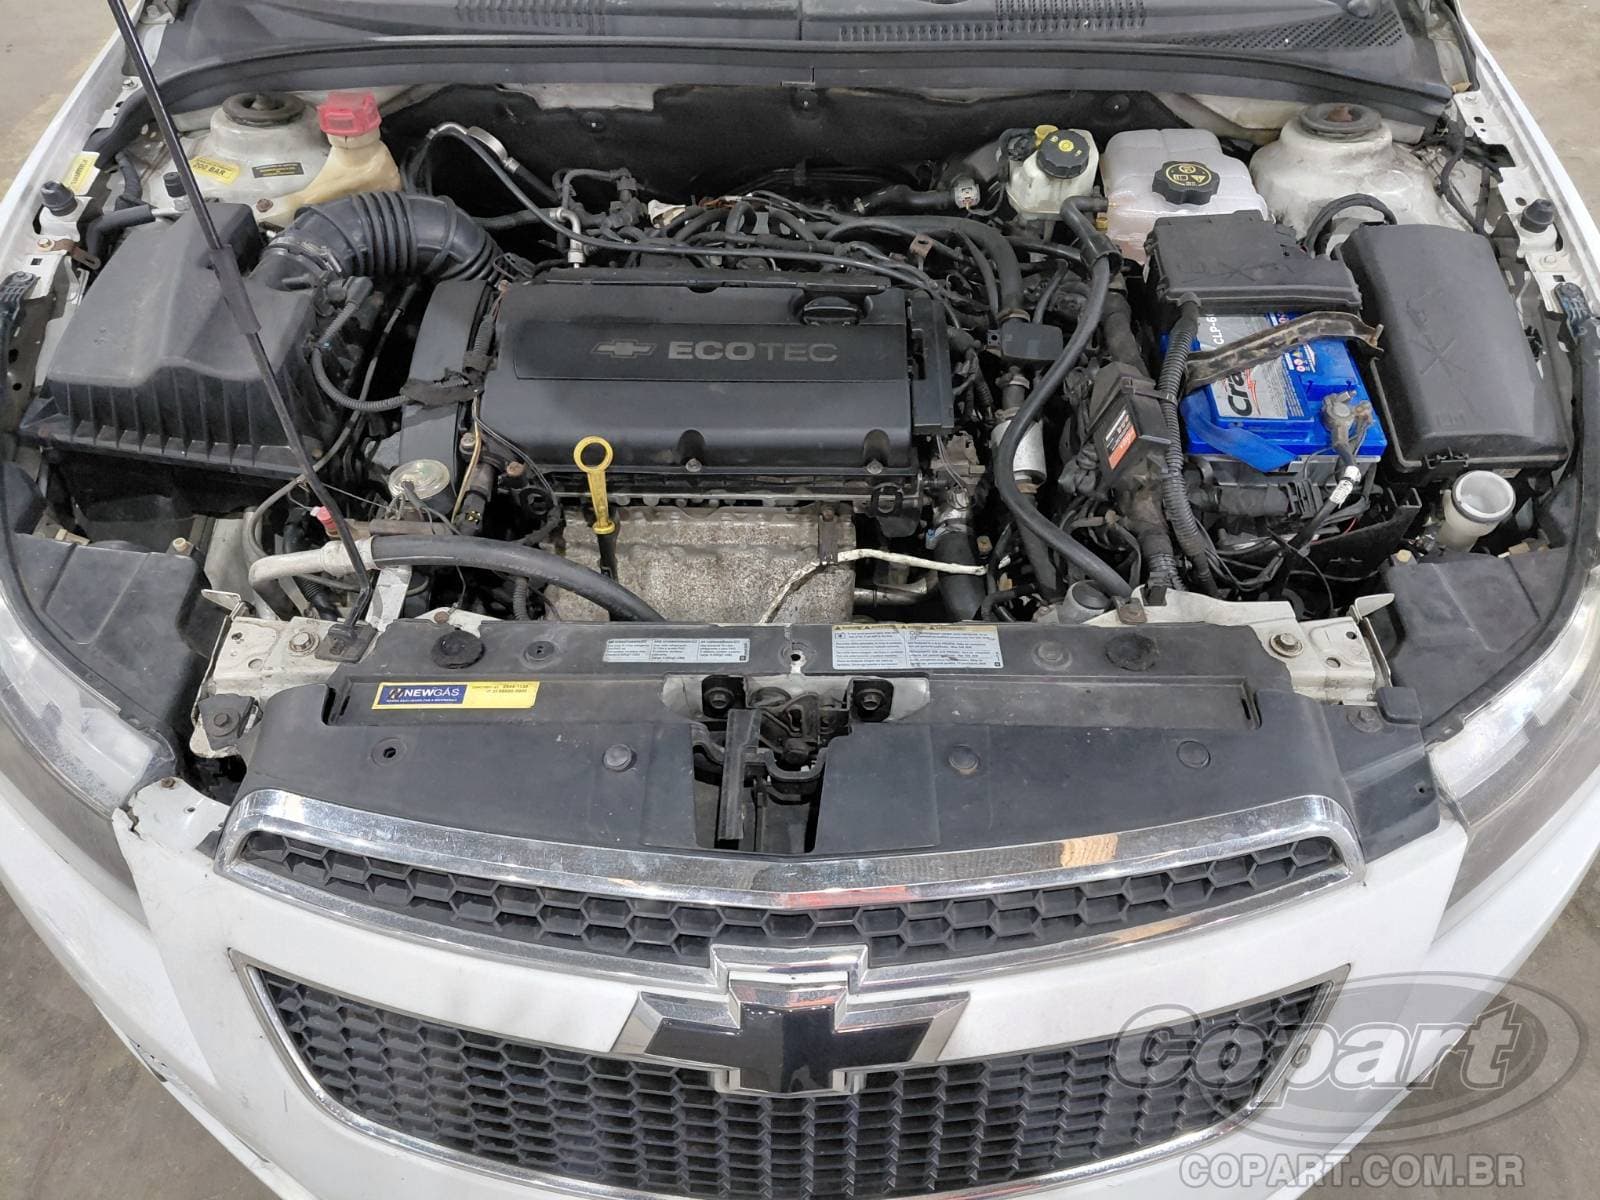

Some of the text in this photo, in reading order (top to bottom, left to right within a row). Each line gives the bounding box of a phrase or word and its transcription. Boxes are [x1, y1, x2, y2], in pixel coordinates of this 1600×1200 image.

[208, 166, 226, 176] BAR
[1206, 314, 1225, 345] CLP-6
[668, 341, 838, 362] ECOTEC
[1227, 372, 1253, 417] Cra
